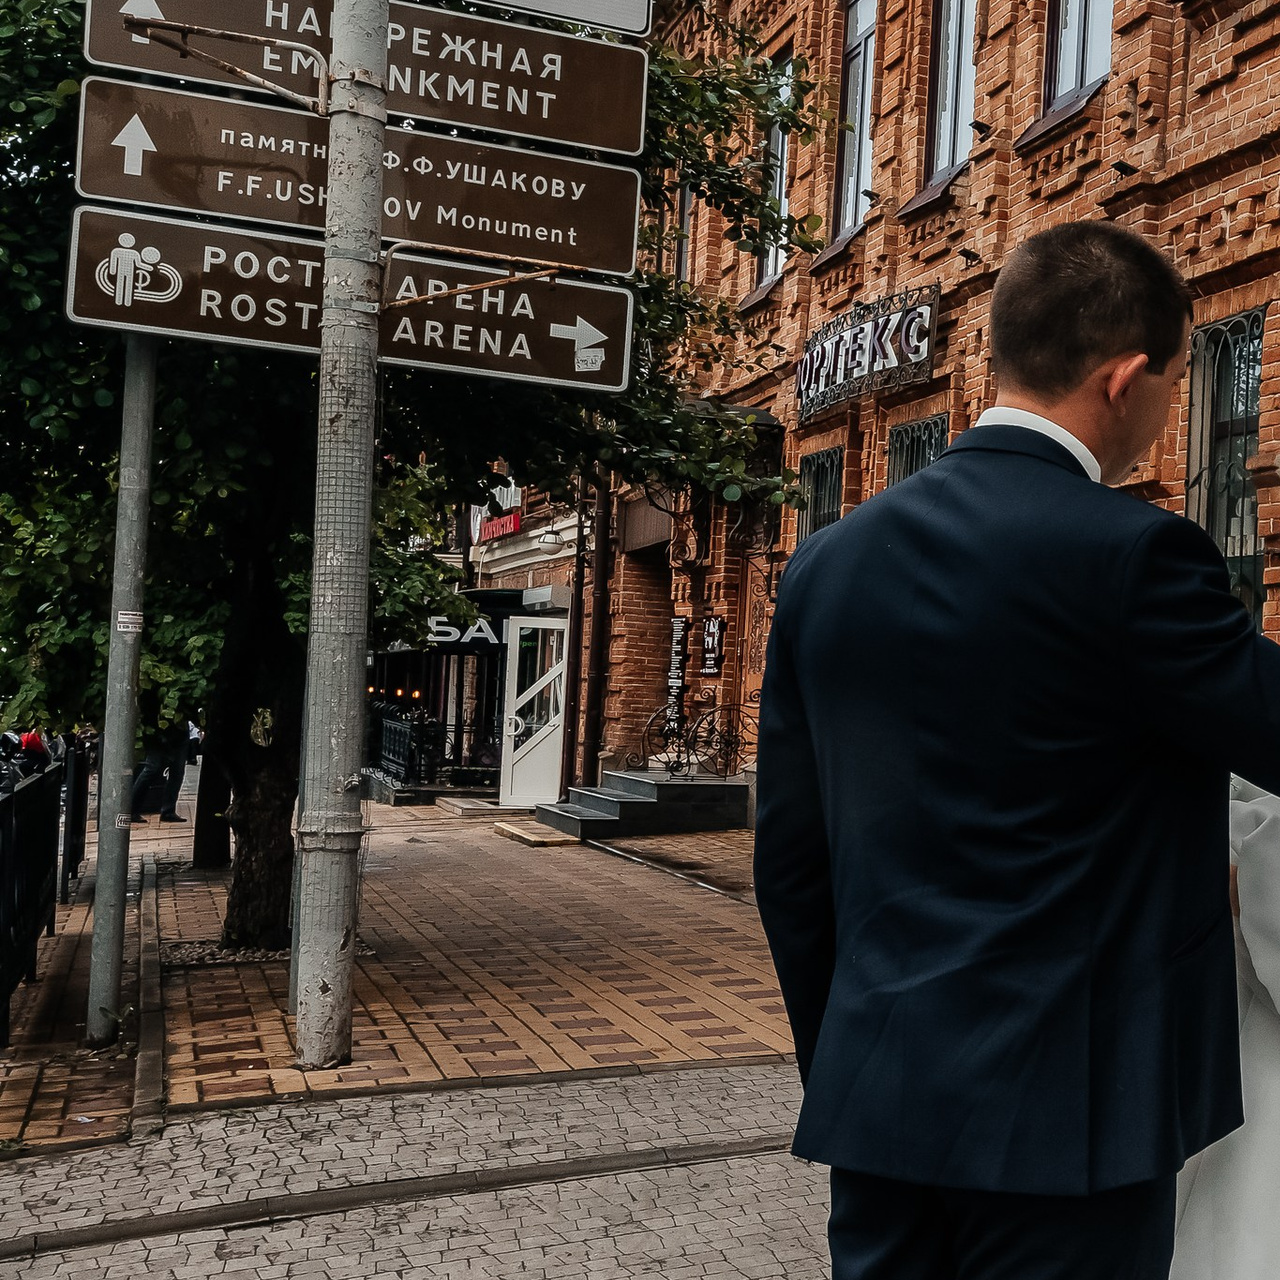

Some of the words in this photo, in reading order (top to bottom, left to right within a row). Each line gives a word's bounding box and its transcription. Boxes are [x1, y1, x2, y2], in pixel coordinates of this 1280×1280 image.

[264, 0, 562, 81] НАРЕЖНАЯ
[262, 45, 557, 119] EMNKMENT
[220, 128, 327, 160] памятн
[217, 170, 422, 221] F.F.USHOV
[436, 205, 578, 246] Monument
[202, 245, 322, 288] РОСТ
[395, 275, 535, 320] АРЕНА
[199, 288, 319, 330] ROST
[392, 316, 533, 360] ARENA
[427, 615, 508, 644] БА
[520, 640, 538, 649] pen
